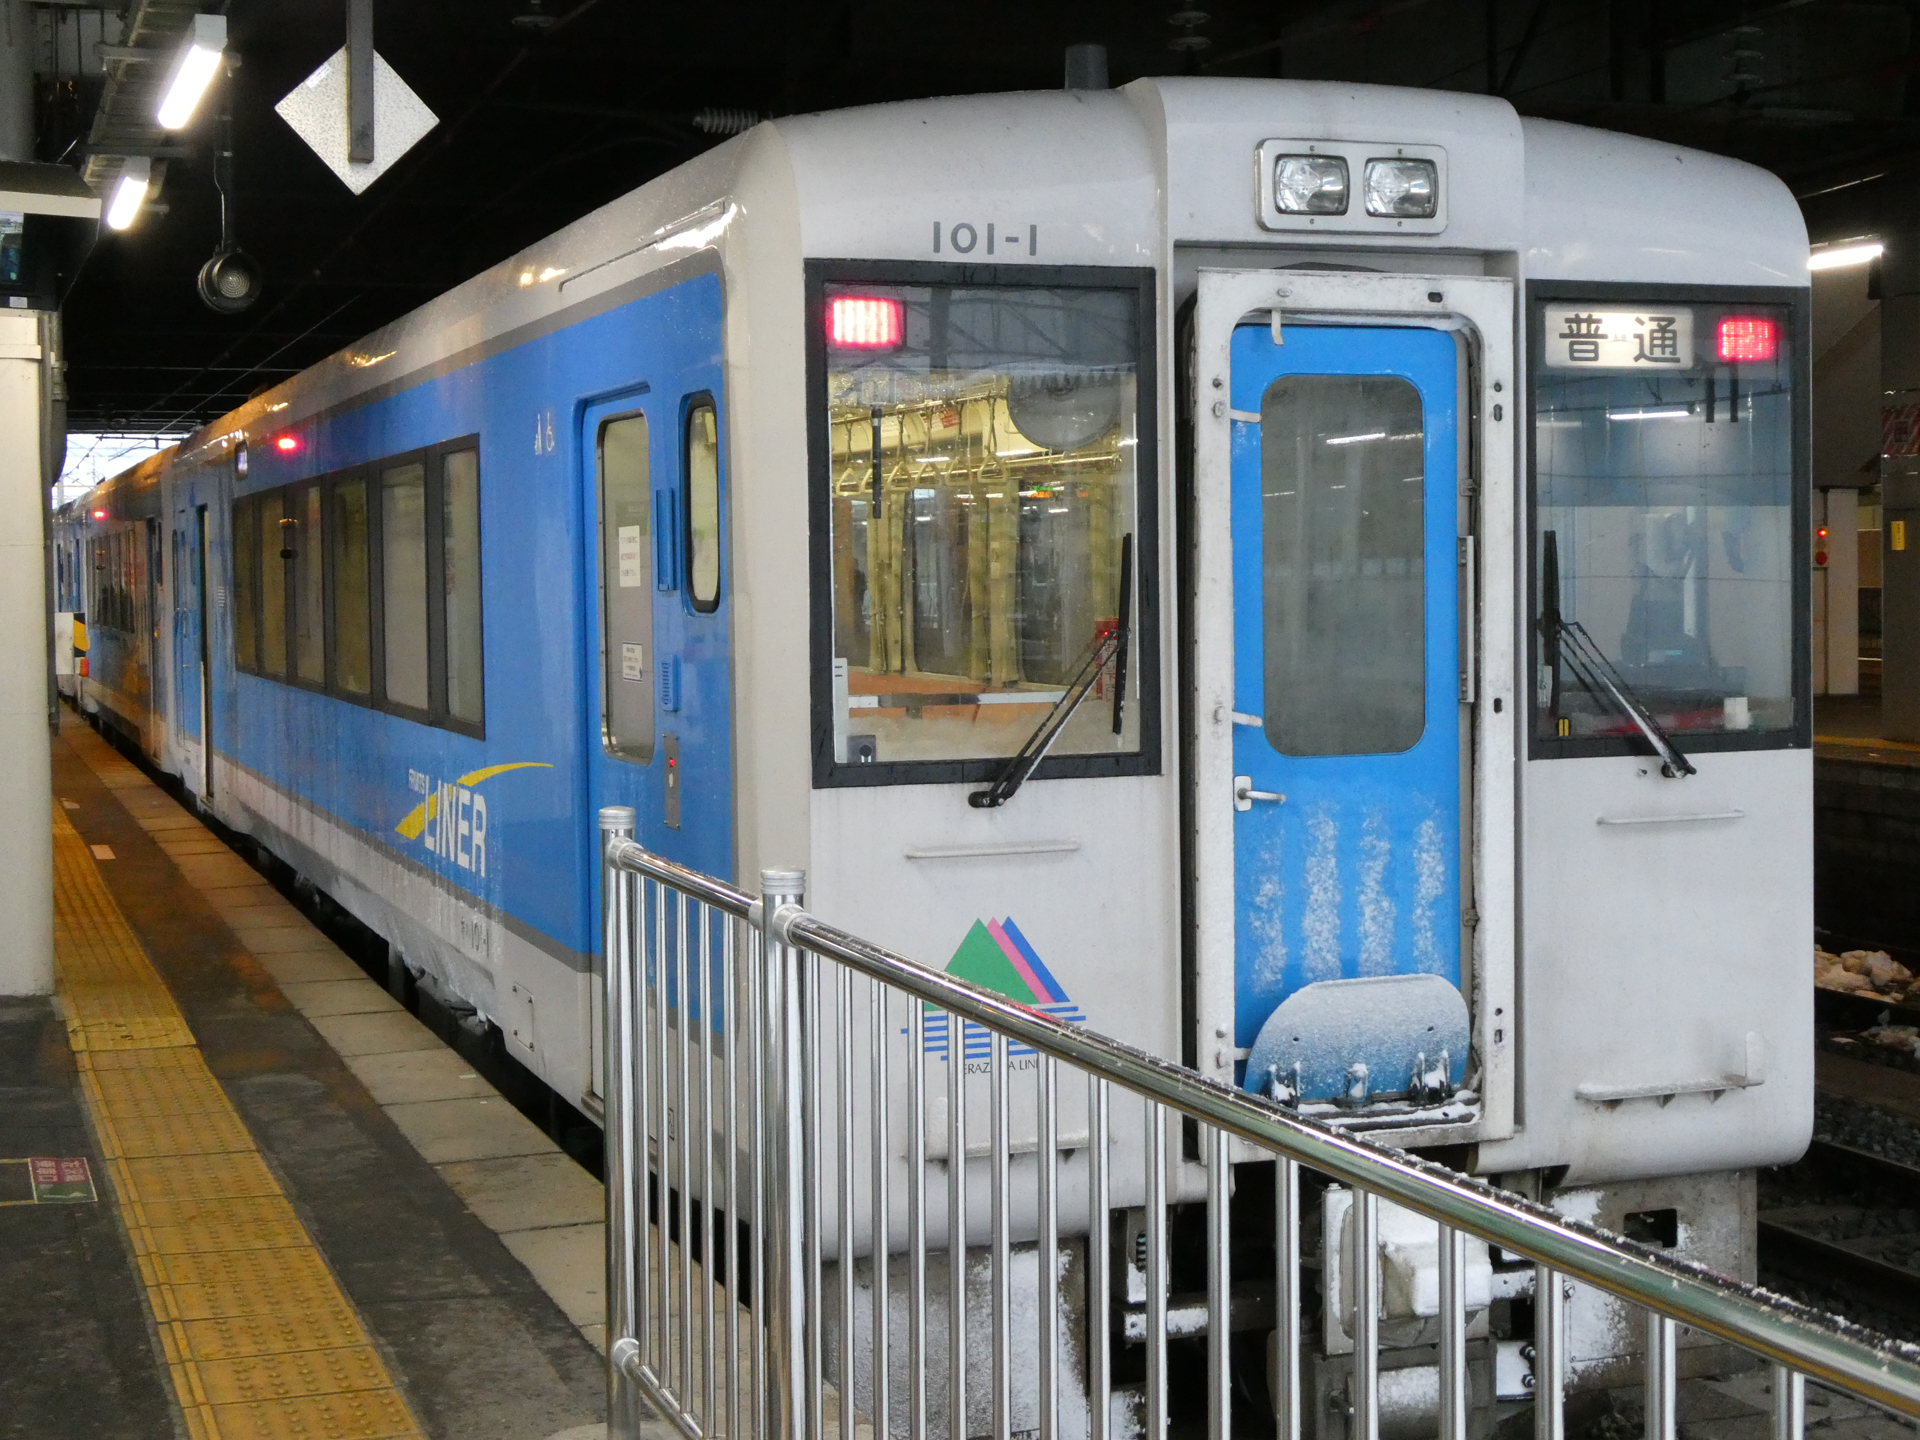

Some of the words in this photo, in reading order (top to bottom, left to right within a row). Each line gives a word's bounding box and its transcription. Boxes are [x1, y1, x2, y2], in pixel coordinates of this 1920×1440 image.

[933, 221, 1037, 256] 101-1
[1559, 312, 1681, 363] 普通
[424, 775, 487, 878] LINER
[1019, 1058, 1039, 1071] LIN
